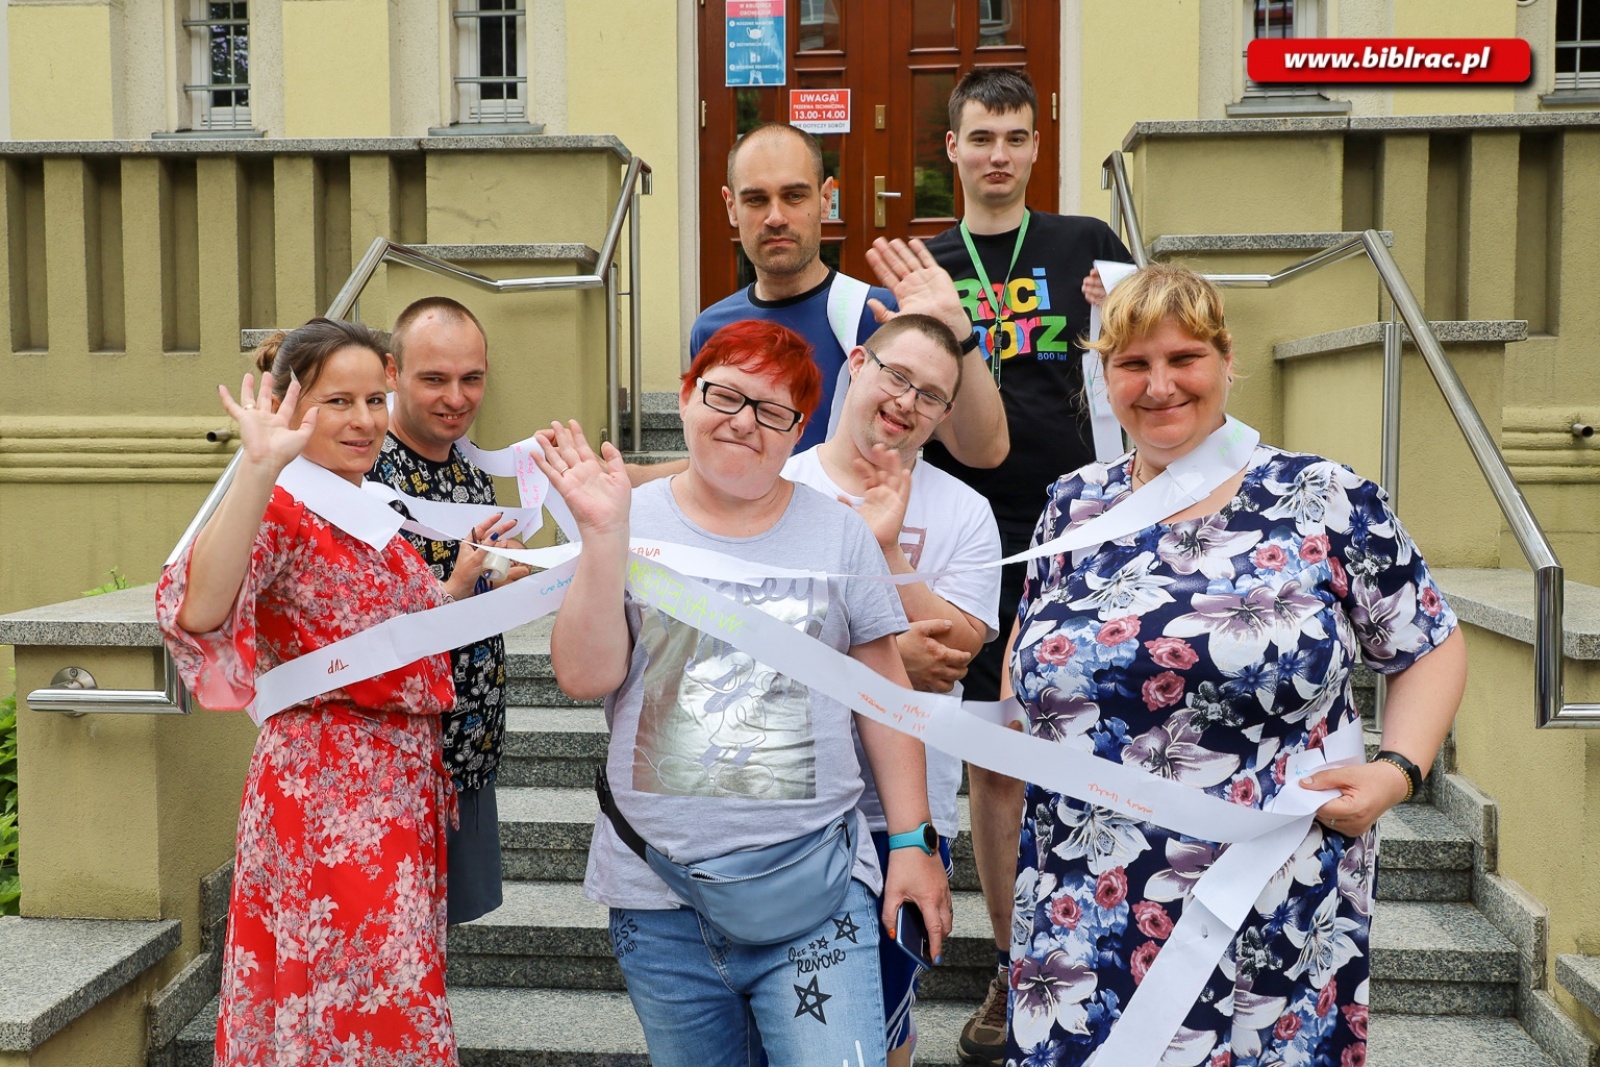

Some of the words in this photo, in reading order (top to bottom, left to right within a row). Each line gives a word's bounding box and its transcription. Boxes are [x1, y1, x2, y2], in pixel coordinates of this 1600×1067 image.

[800, 93, 839, 102] UWAGA!
[794, 110, 846, 119] 13.00-14.00
[1037, 352, 1055, 361] 800
